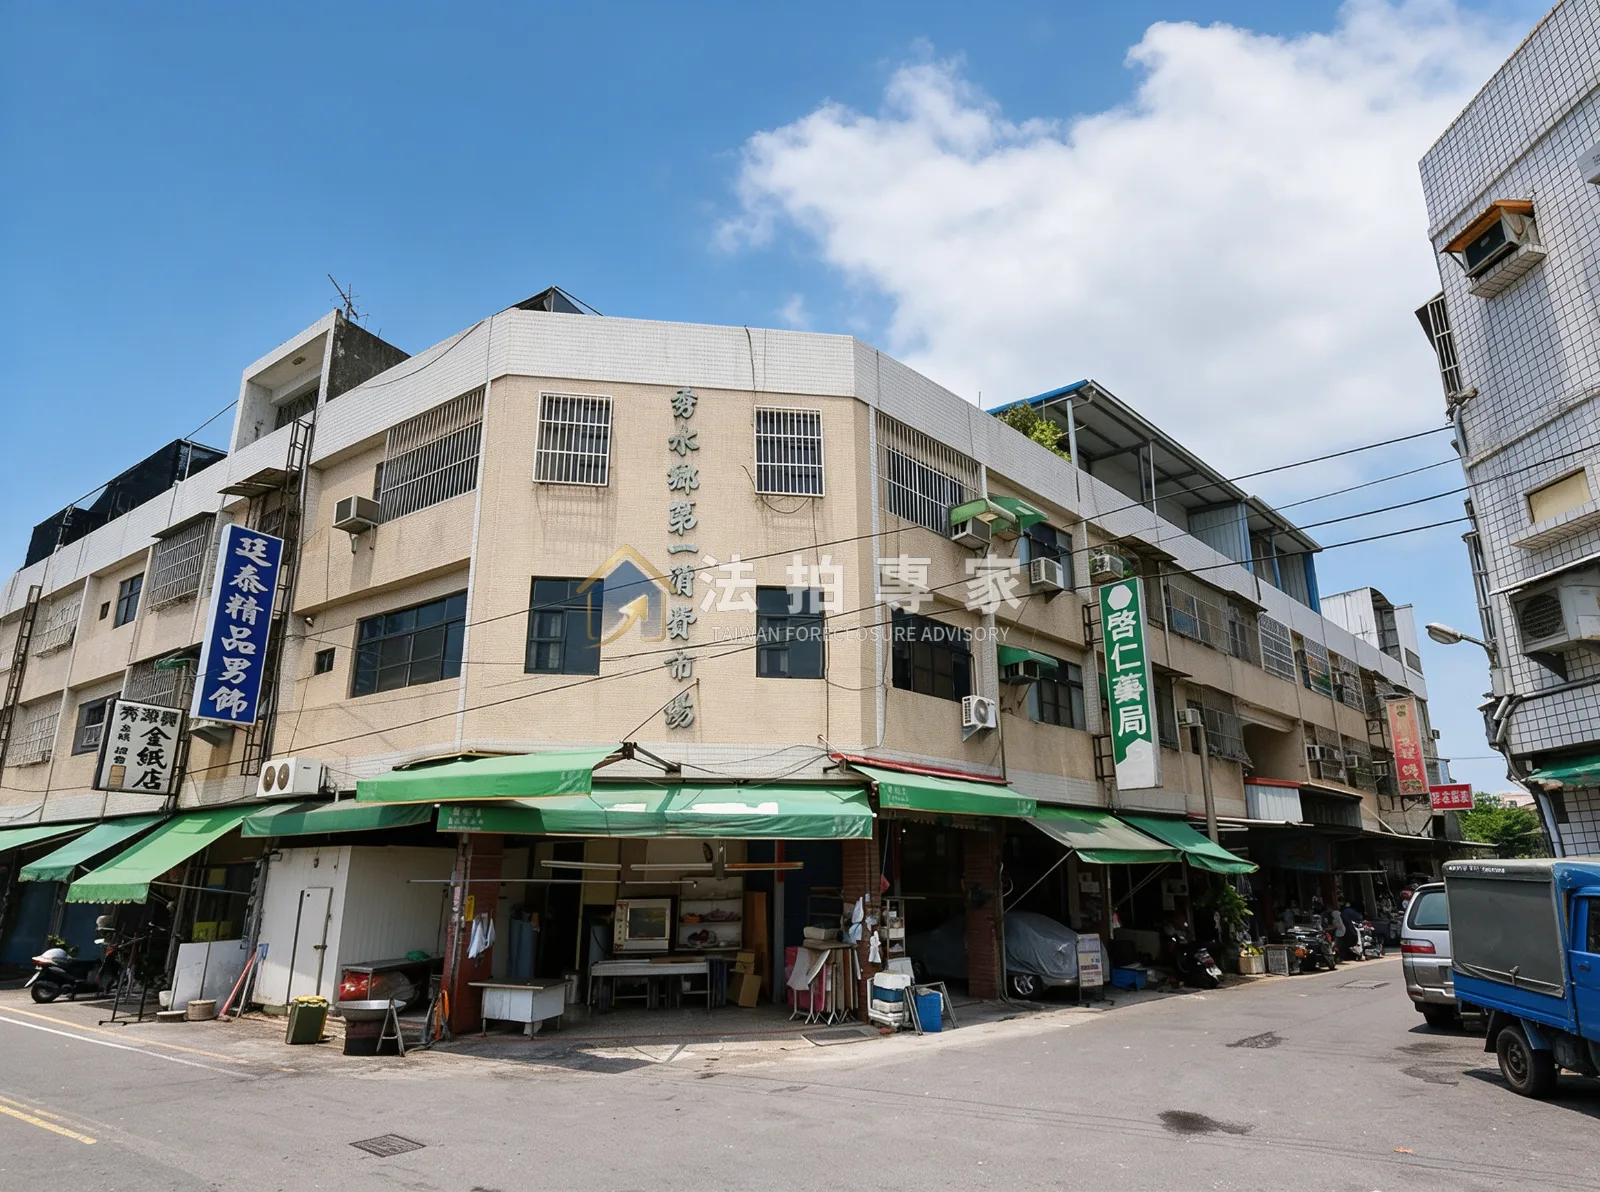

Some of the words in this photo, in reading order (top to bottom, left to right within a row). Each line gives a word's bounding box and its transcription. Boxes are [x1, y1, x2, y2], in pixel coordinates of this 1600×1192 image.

[664, 387, 700, 730] 秀水鄉第一消費市場
[132, 725, 172, 790] 金紙店
